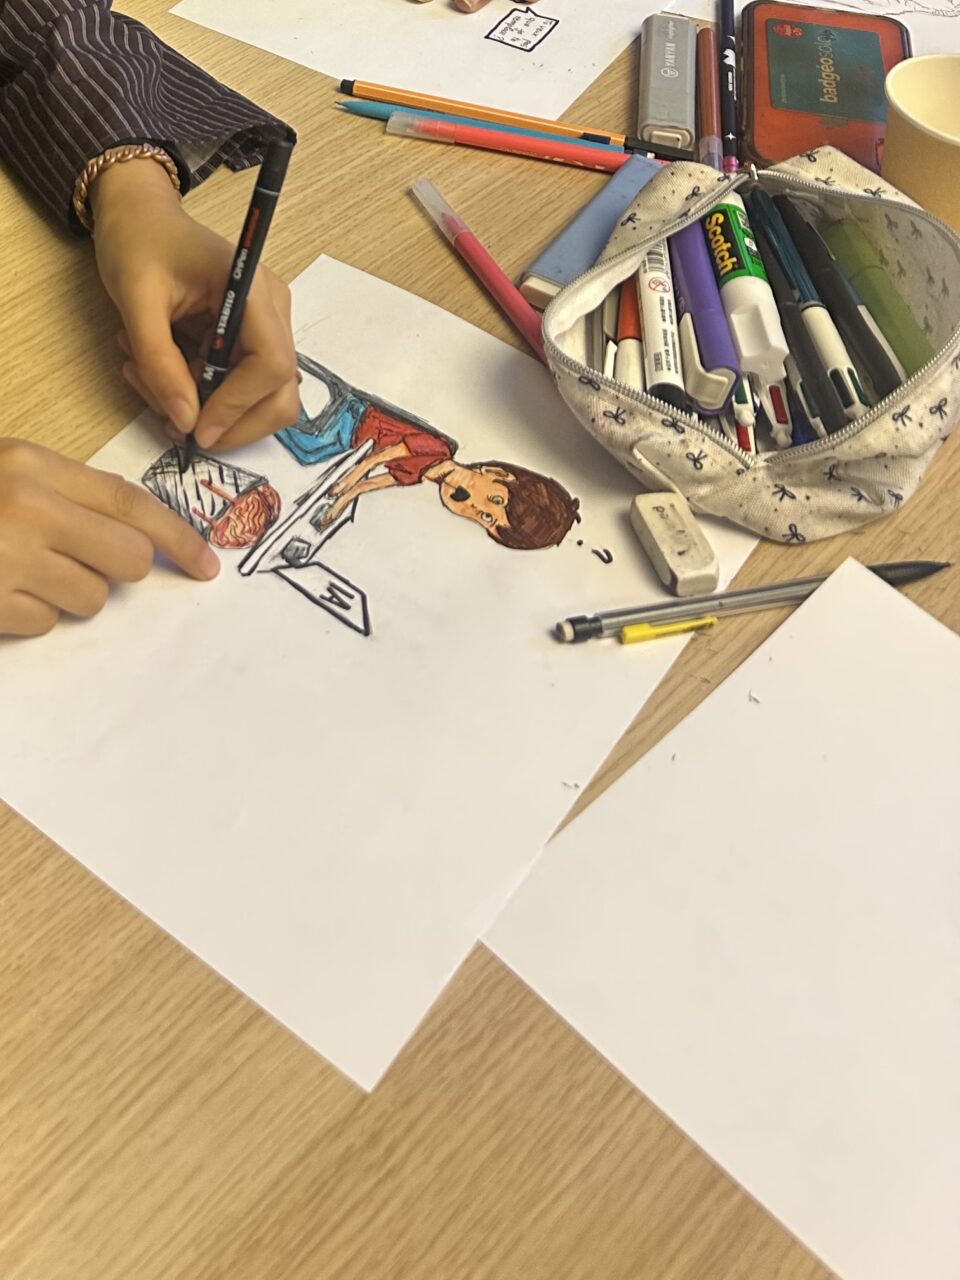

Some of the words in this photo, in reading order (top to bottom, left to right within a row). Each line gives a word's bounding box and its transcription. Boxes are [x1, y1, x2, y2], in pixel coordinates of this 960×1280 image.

[705, 211, 738, 276] Scotch
[217, 290, 236, 335] STABILO
[319, 579, 355, 611] IA
